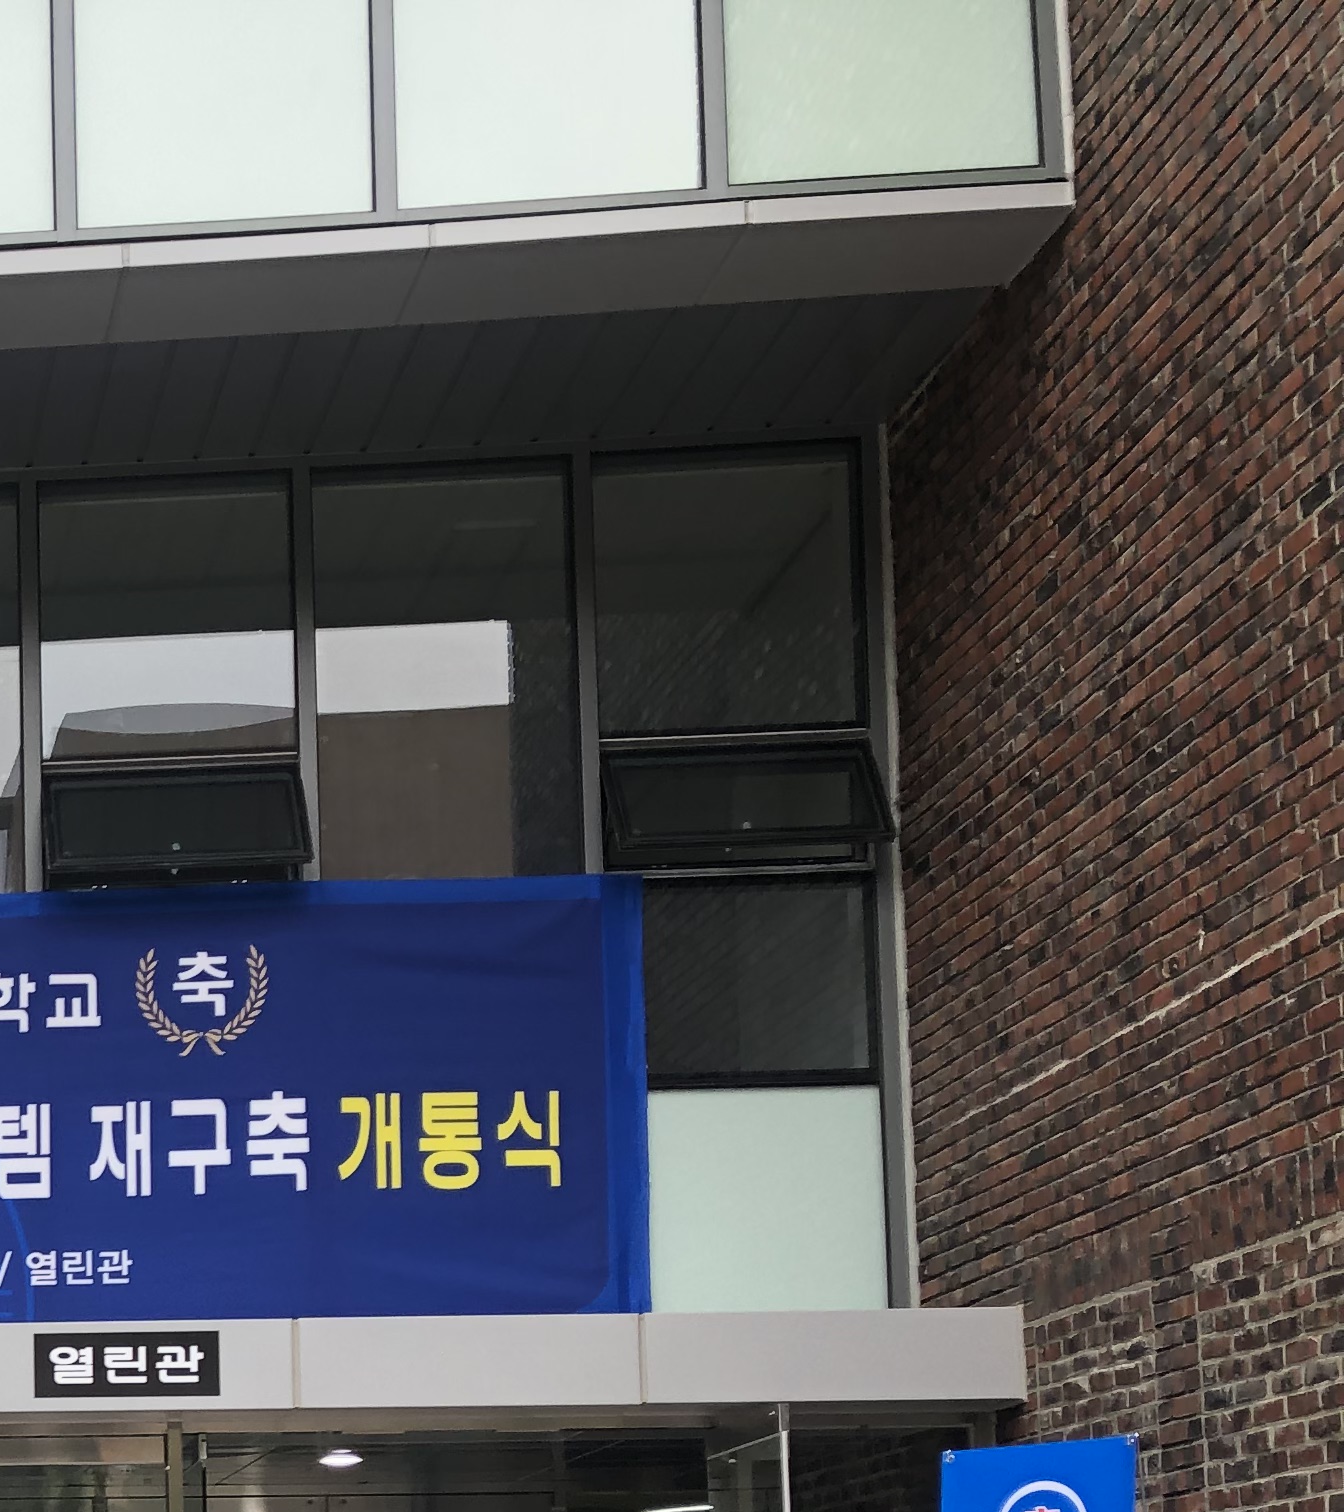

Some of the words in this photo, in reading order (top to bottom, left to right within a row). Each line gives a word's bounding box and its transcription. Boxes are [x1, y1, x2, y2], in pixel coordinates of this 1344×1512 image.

[172, 951, 234, 1017] 축
[89, 1090, 310, 1197] 재구축
[337, 1090, 562, 1190] 개통식
[25, 1249, 133, 1286] 열린관
[48, 1344, 206, 1386] 열린관
